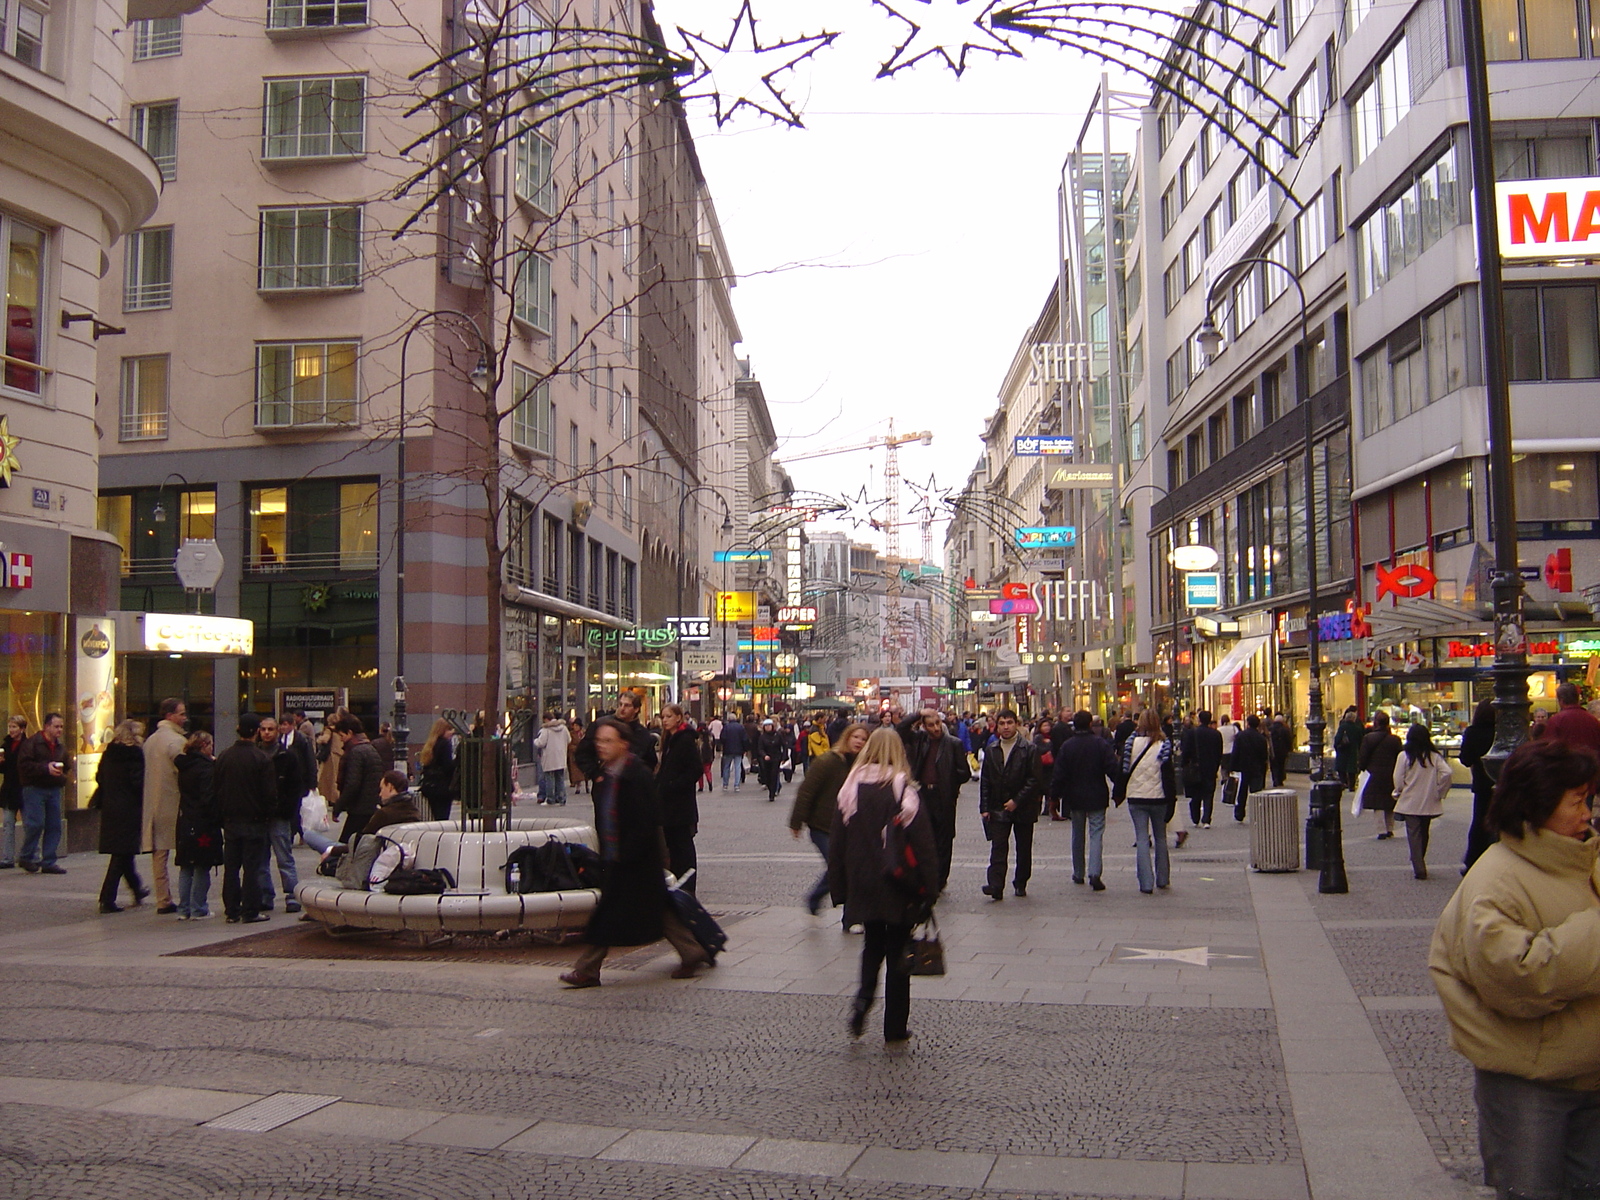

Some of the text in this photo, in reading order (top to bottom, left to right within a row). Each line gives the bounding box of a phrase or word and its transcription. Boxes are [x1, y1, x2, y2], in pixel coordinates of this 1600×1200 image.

[1508, 190, 1600, 245] MA
[1029, 342, 1098, 385] STEFFL
[36, 490, 48, 502] 20
[1032, 580, 1101, 621] STEFFL
